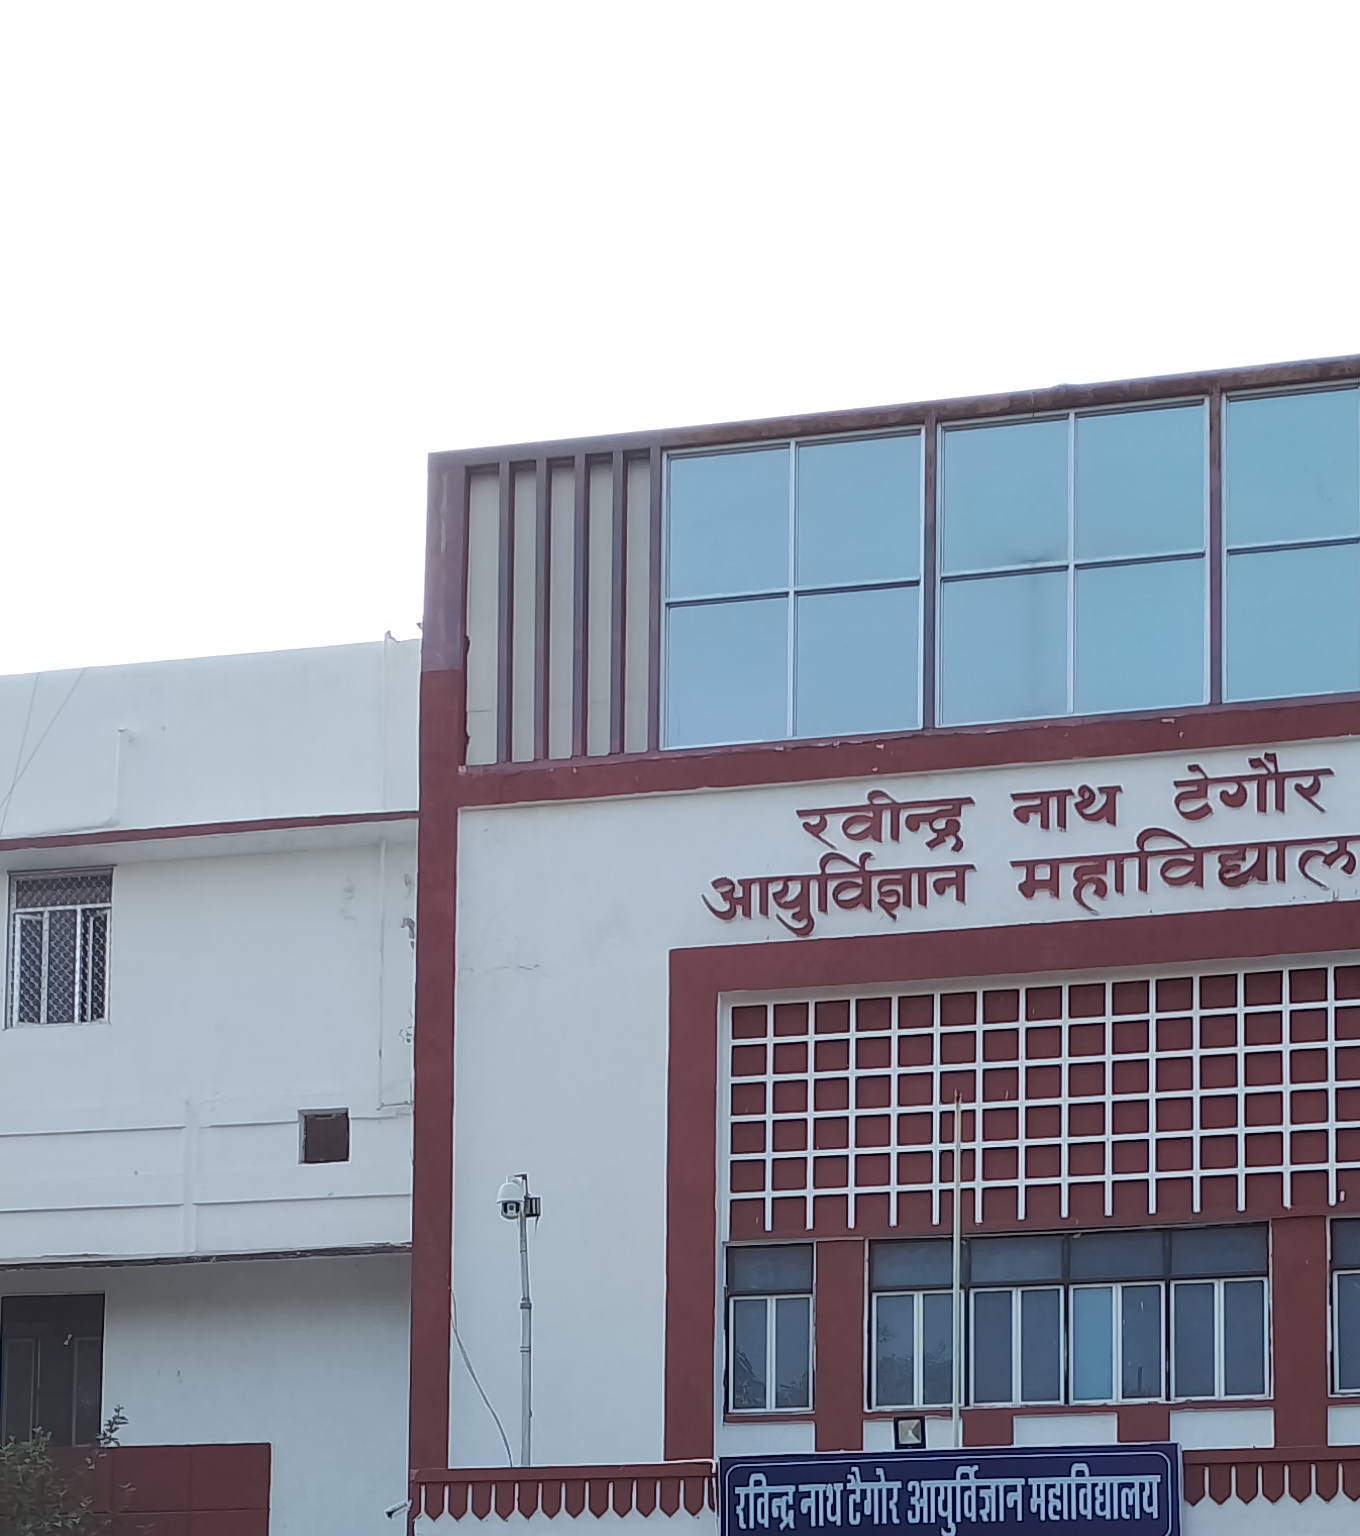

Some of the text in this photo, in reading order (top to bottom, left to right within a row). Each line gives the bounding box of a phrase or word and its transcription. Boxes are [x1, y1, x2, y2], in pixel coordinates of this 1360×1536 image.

[796, 752, 1334, 852] रवीन्द्र नाथ टेगौर
[702, 852, 977, 938] आयुर्विज्ञान
[735, 1473, 796, 1530] रविन्द्र
[798, 1483, 844, 1527] नाथ
[846, 1466, 902, 1525] टैगोर
[1028, 1463, 1161, 1520] महाविद्यालय
